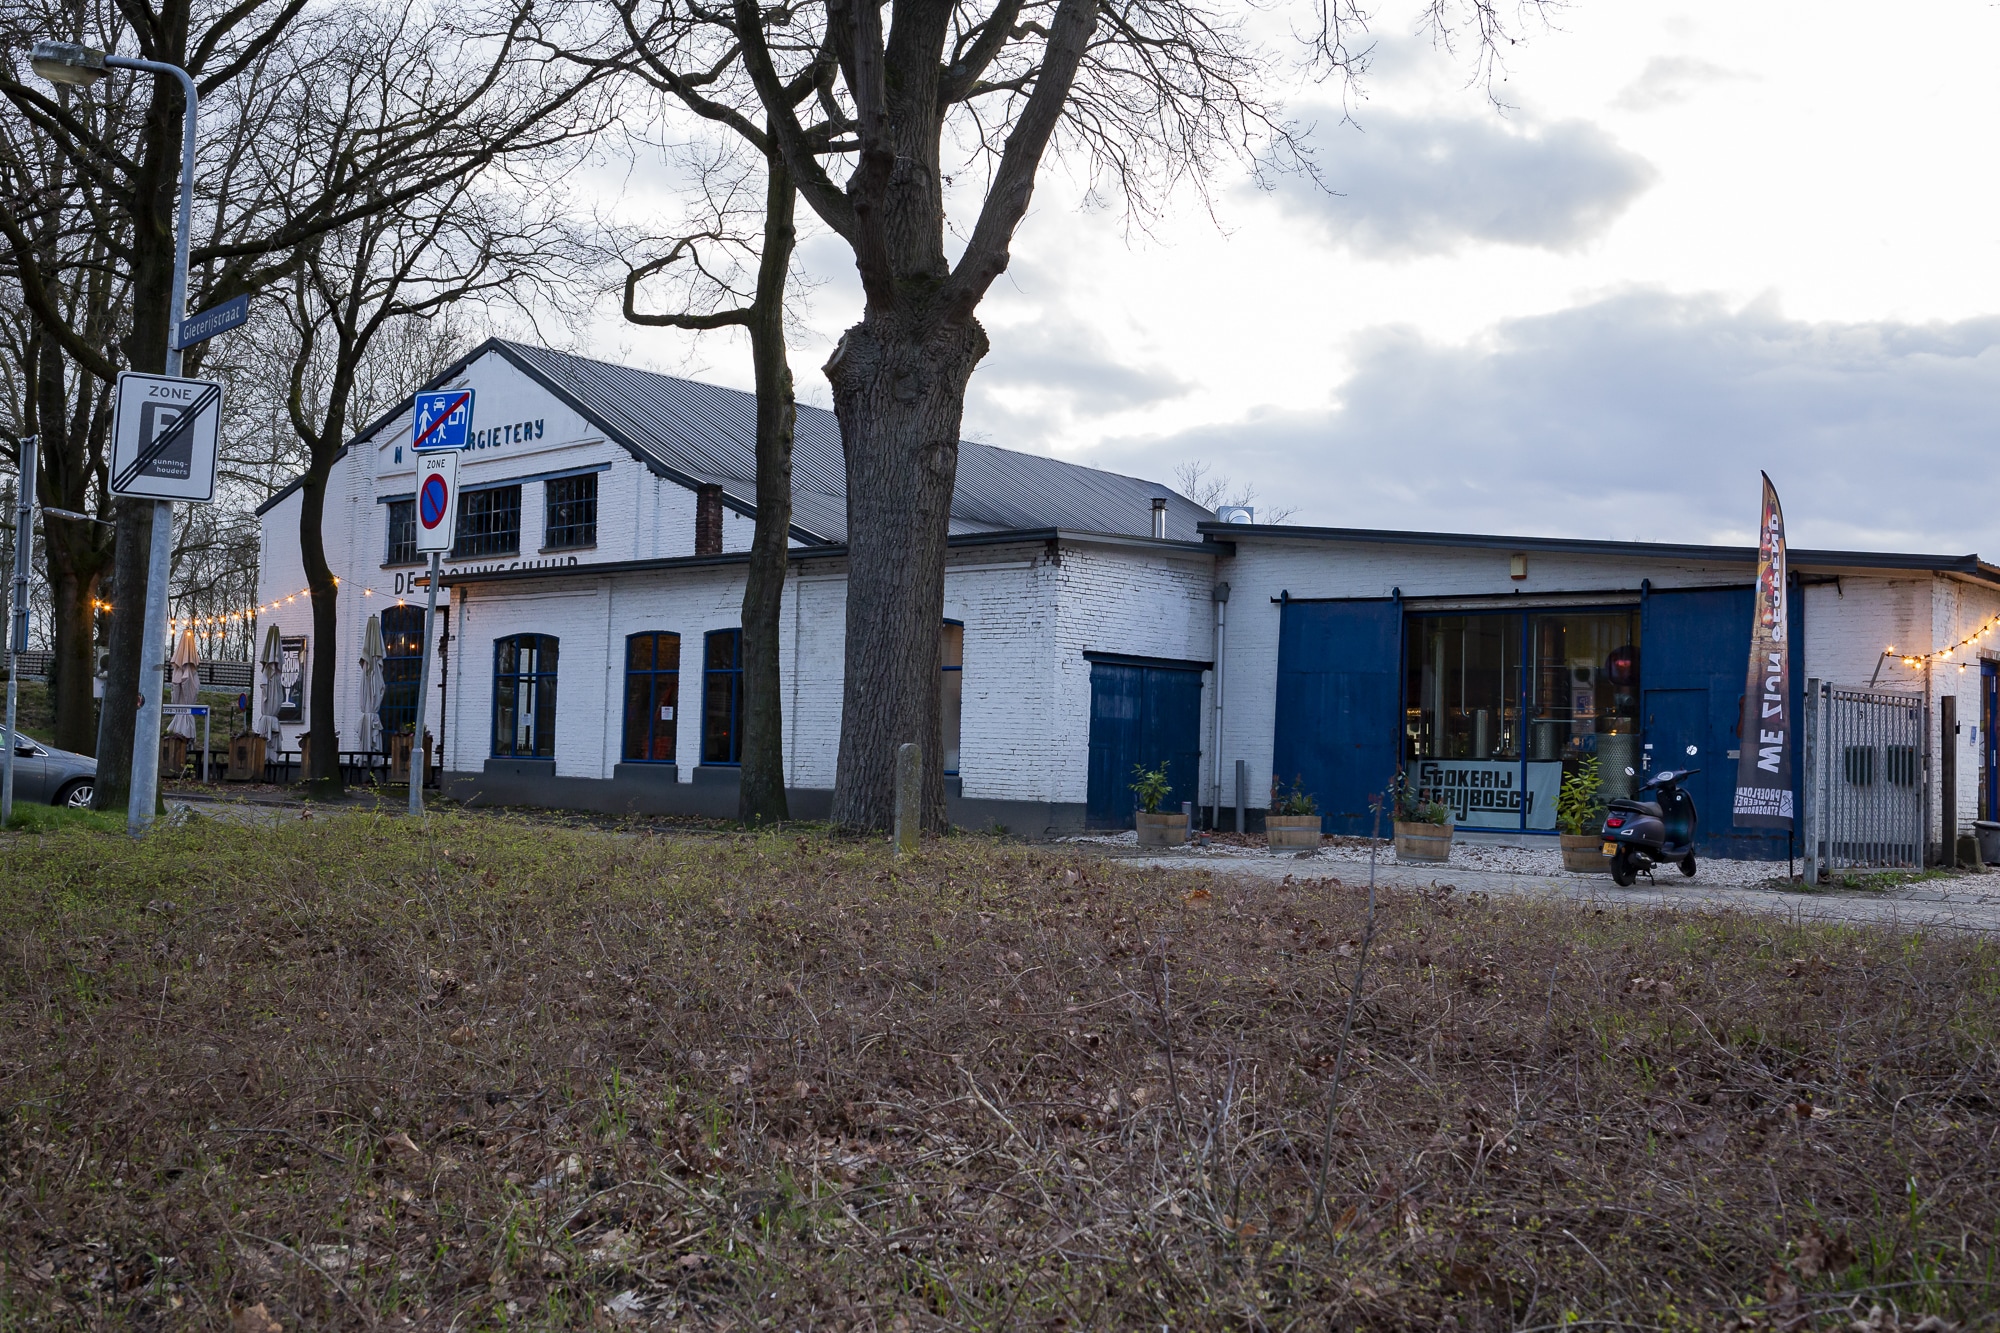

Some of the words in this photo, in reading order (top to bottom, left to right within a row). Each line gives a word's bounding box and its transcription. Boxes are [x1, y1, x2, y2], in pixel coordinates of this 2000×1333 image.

[183, 306, 240, 341] Gieterijstraat
[149, 385, 192, 400] ZONE
[150, 458, 189, 468] gunning-
[426, 458, 446, 470] ZONE
[156, 466, 188, 475] houders
[394, 572, 416, 595] DE
